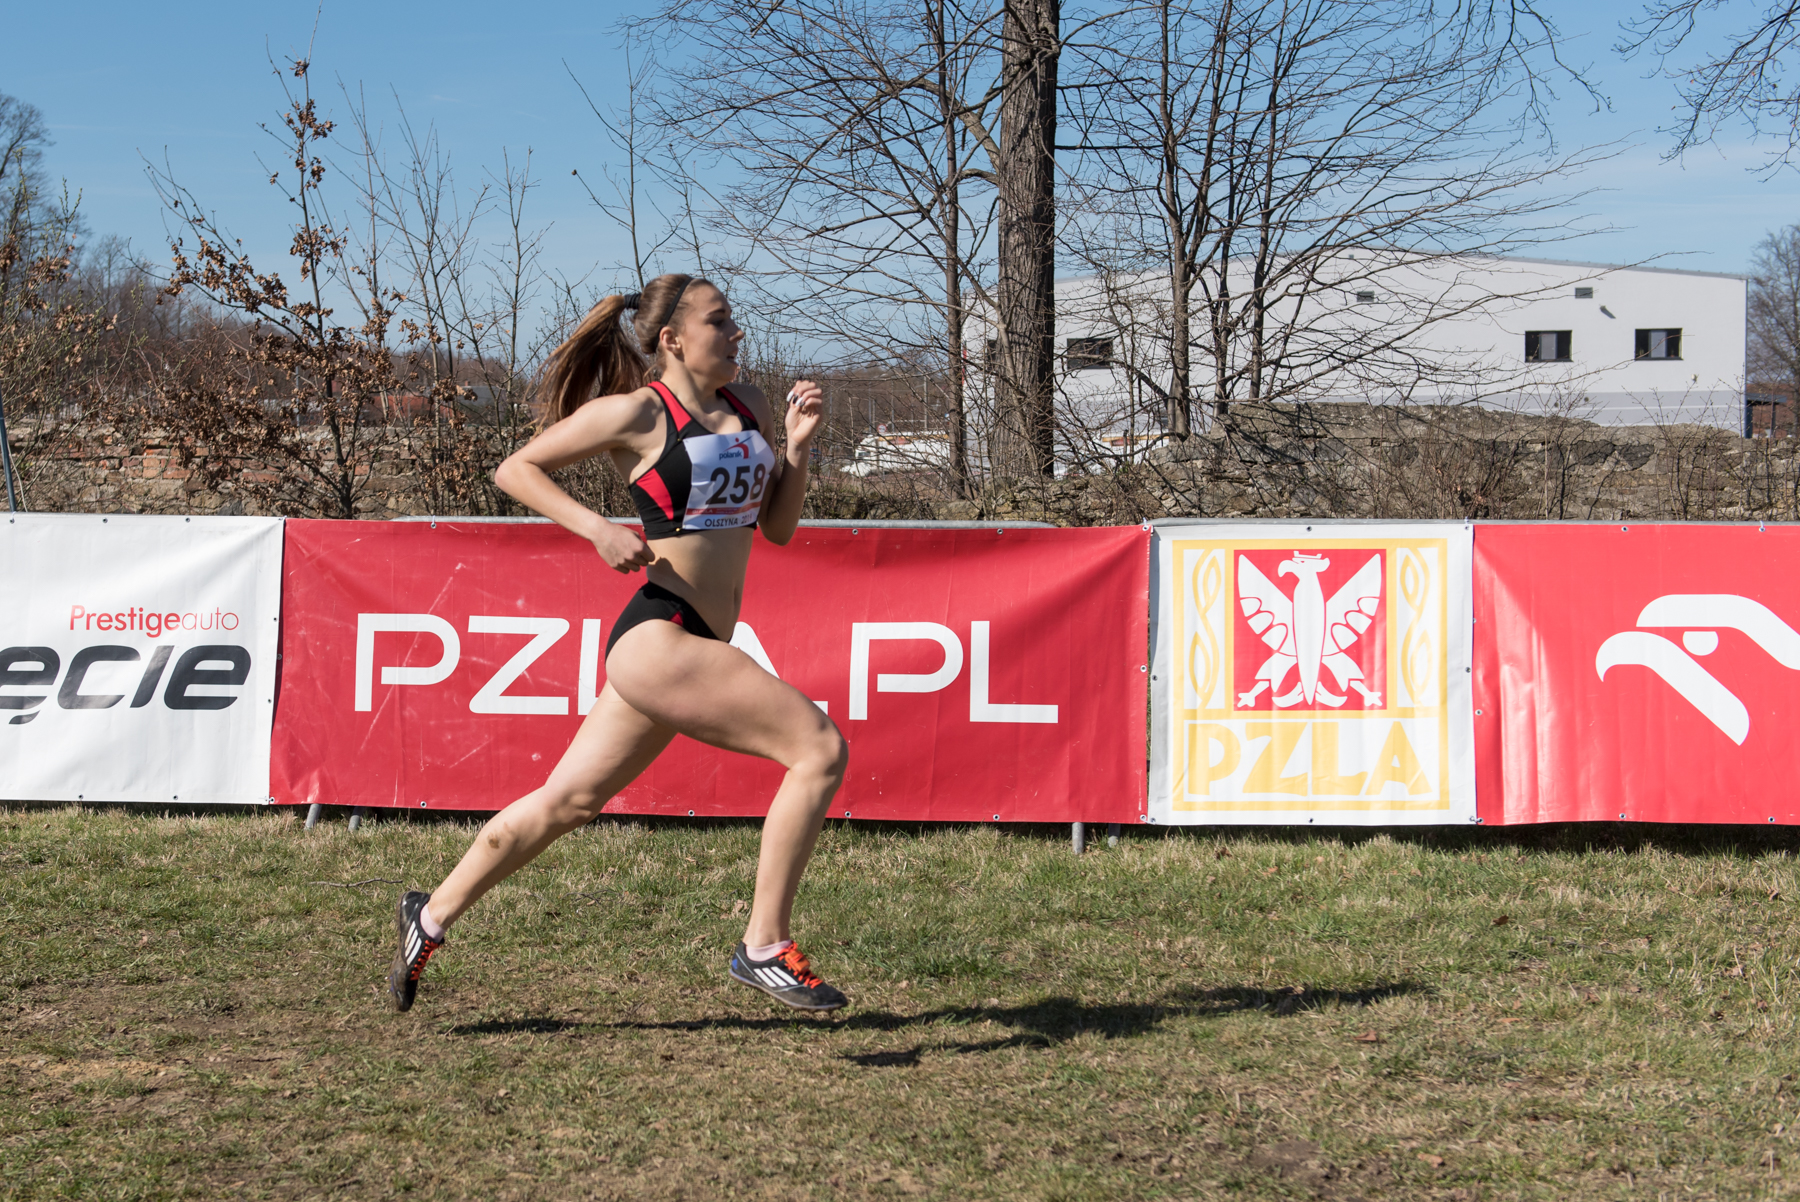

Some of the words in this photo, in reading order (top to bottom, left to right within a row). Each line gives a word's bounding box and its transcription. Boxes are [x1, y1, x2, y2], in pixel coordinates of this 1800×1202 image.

[719, 450, 742, 460] polanik
[705, 463, 766, 505] 258
[704, 517, 739, 527] OLSZYNA
[69, 605, 239, 638] Prestigeauto
[1188, 720, 1433, 797] PZLA
